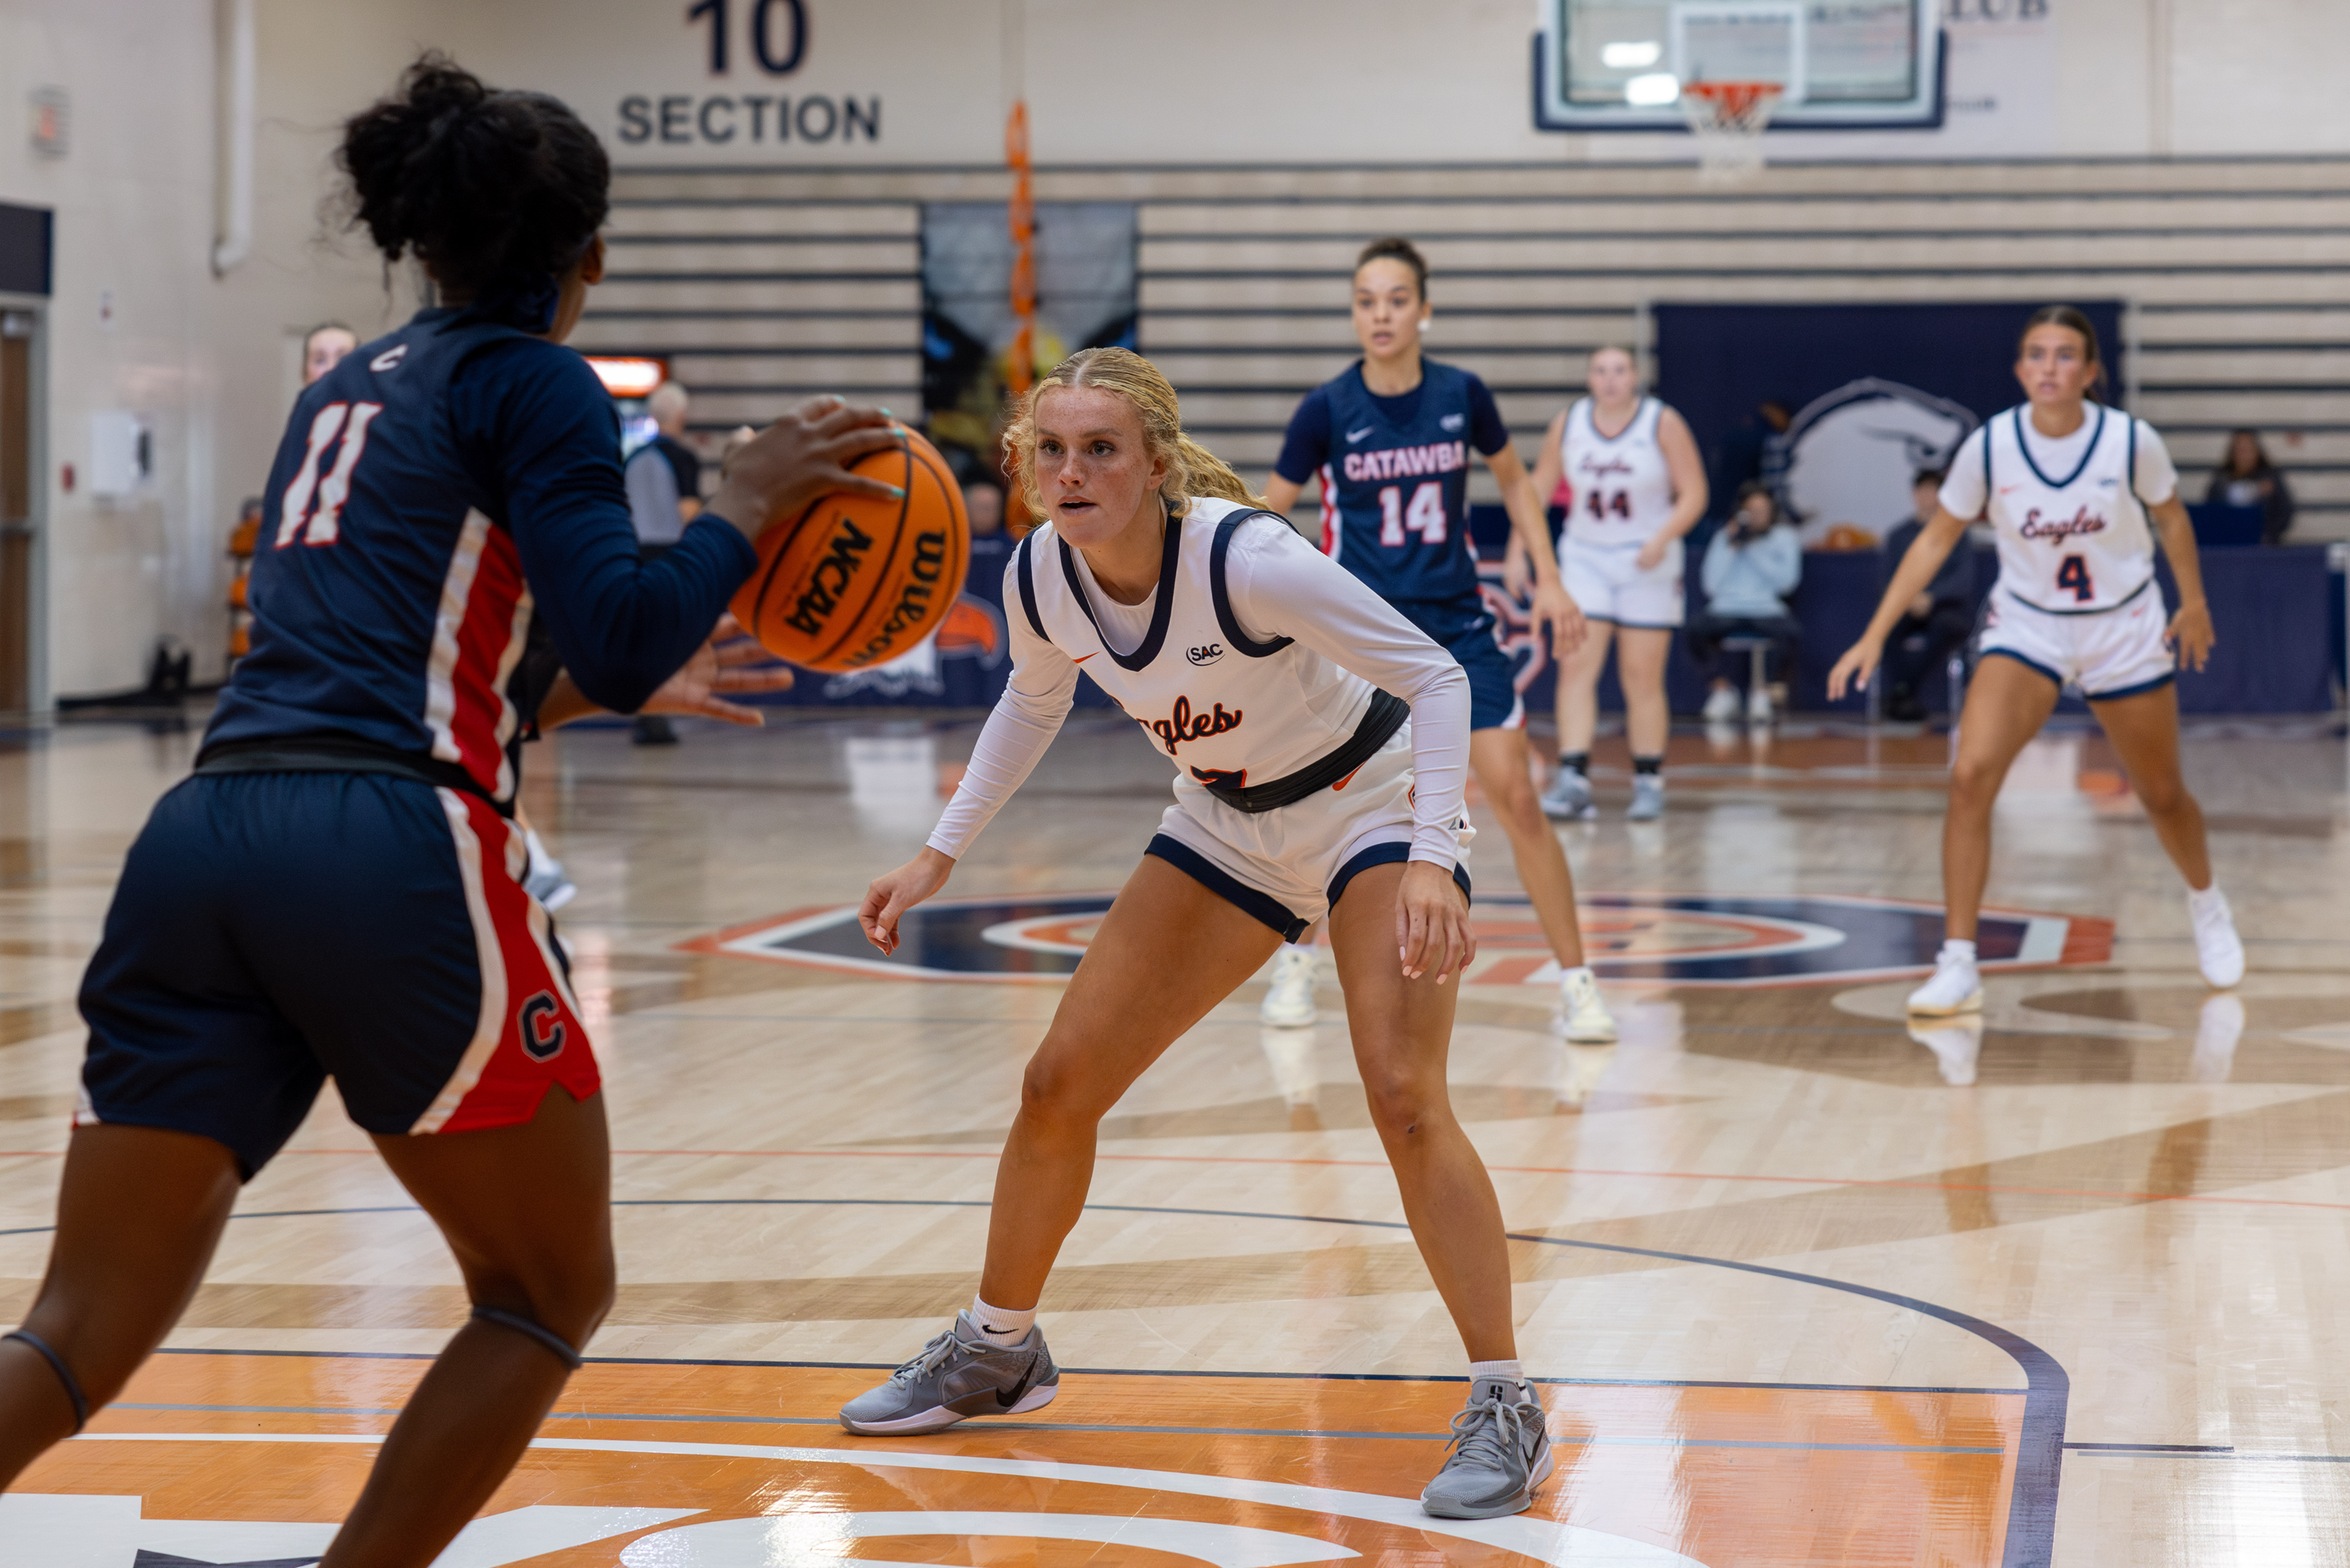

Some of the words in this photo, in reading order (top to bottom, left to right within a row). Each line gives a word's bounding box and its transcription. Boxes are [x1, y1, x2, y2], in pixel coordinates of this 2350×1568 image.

[688, 0, 810, 77] 10
[617, 95, 882, 144] SECTION
[273, 400, 384, 550] 11
[1378, 481, 1447, 547] 14
[2020, 502, 2107, 547] Eagles
[783, 516, 876, 639] NCAA
[2055, 553, 2096, 605] 4
[1190, 643, 1224, 662] SAC
[1136, 695, 1243, 756] gles
[517, 988, 567, 1064] C
